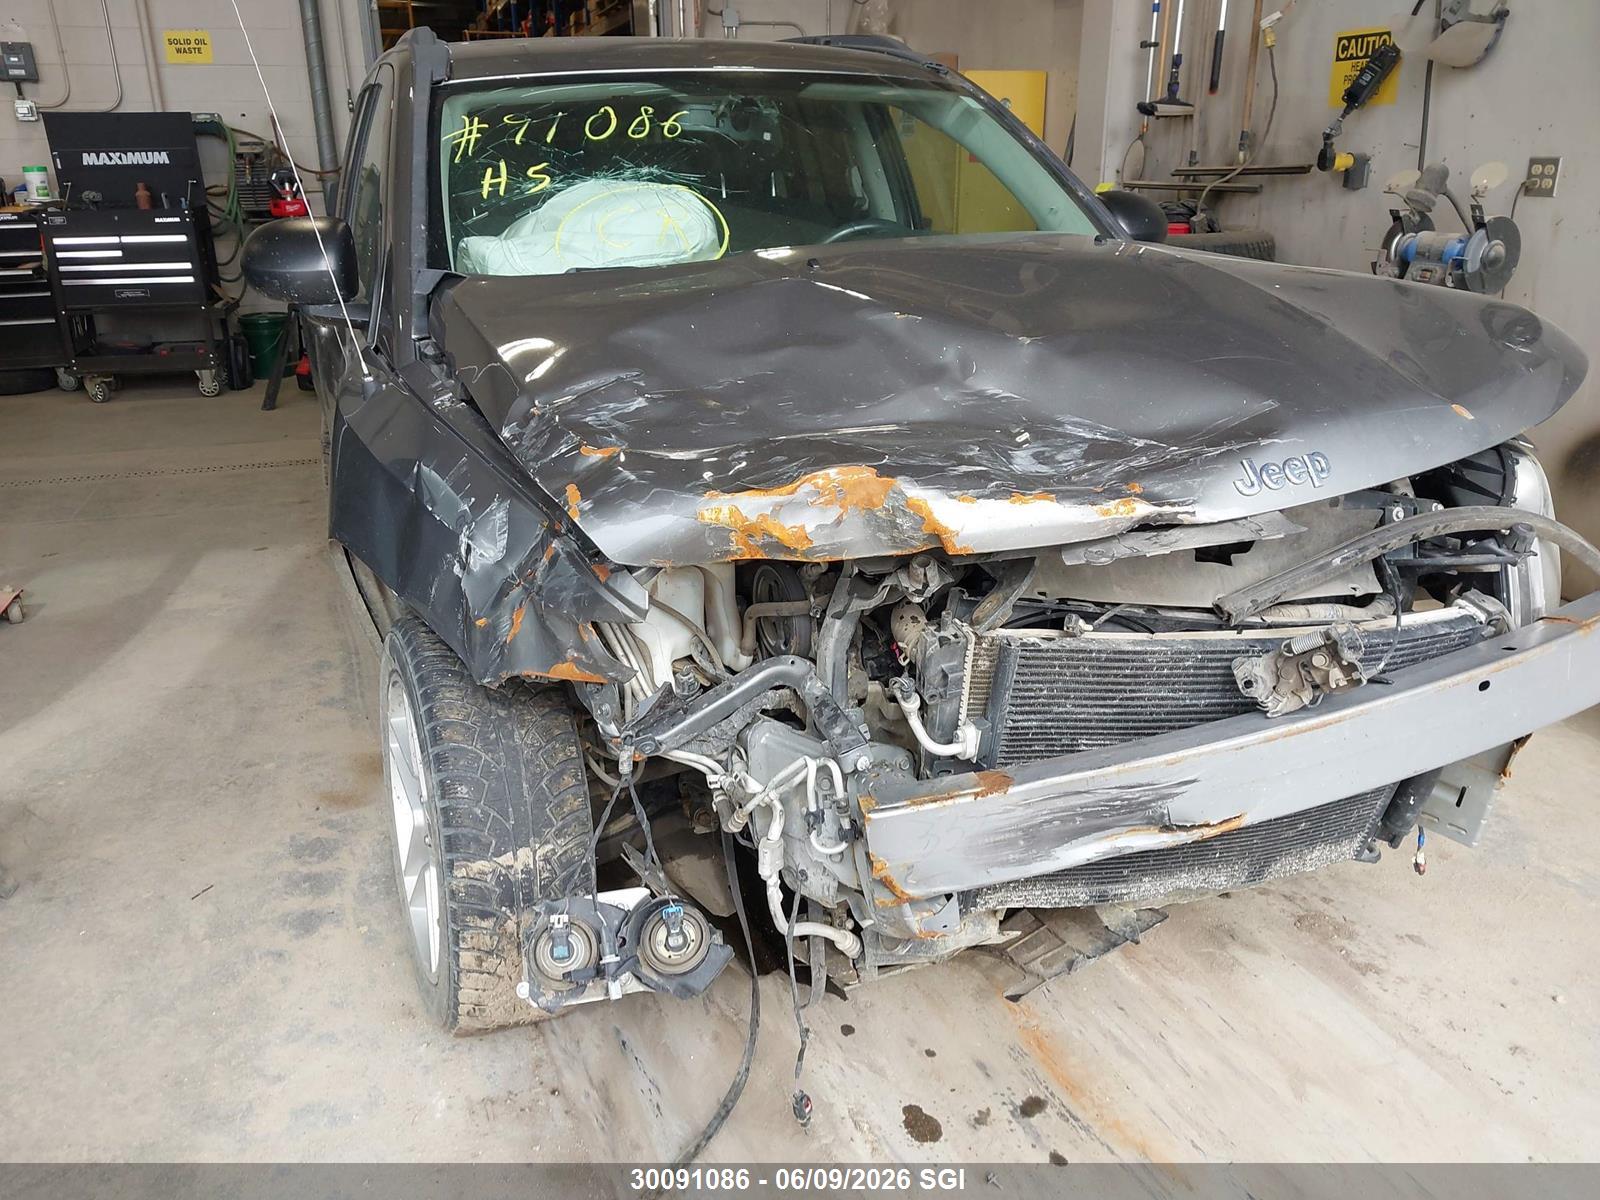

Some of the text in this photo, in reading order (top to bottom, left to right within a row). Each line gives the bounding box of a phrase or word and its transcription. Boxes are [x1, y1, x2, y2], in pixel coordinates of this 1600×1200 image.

[167, 38, 208, 46] SOLID OIL
[1338, 34, 1393, 59] CAUTIO
[175, 47, 203, 55] WASTE
[82, 151, 170, 166] MAXIMUM
[1233, 451, 1331, 496] Jeep
